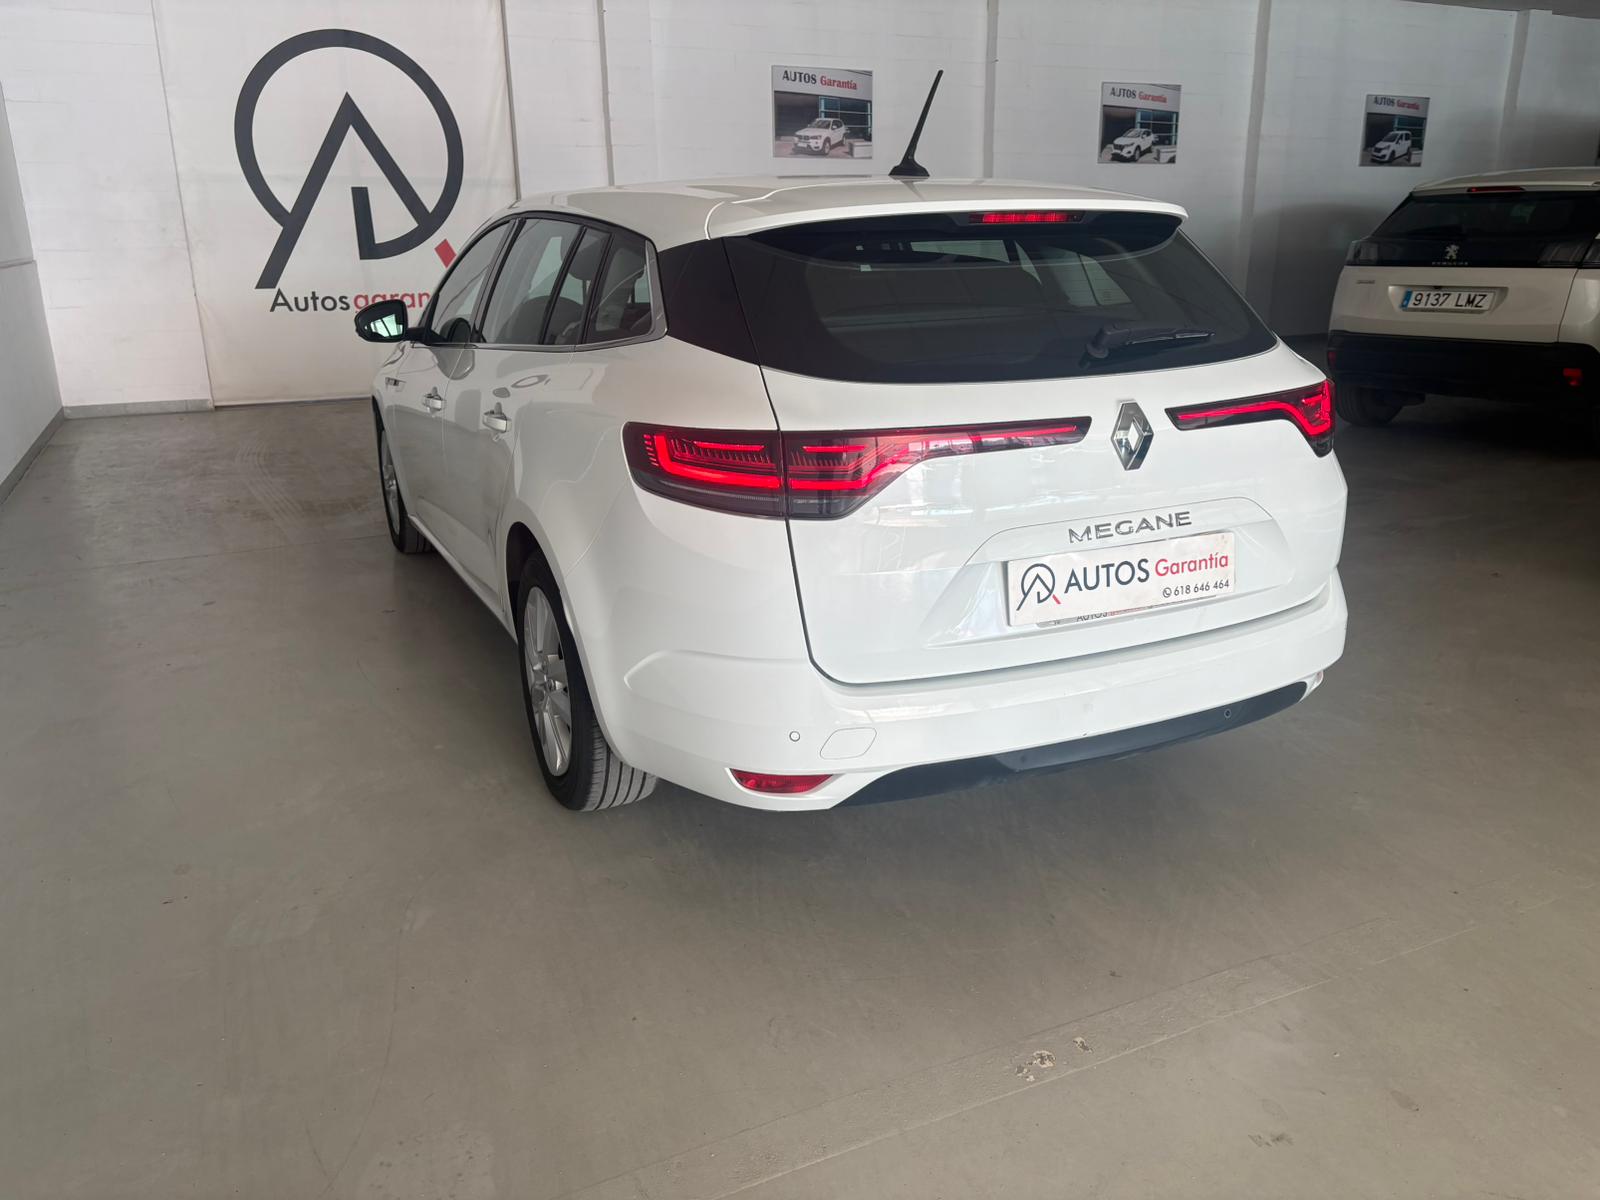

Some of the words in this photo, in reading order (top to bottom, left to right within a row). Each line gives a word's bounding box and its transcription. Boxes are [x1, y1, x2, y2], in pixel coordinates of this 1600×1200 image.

[782, 69, 817, 85] AUTOS
[1110, 87, 1137, 99] AUTOS
[1413, 293, 1452, 306] 9137
[1455, 293, 1487, 308] LMZ
[1068, 511, 1192, 543] MEGANE
[1064, 558, 1150, 594] AUTOS
[1155, 552, 1229, 577] Garantía
[1174, 584, 1191, 596] 618
[1193, 581, 1211, 593] 646
[1213, 579, 1230, 590] 464
